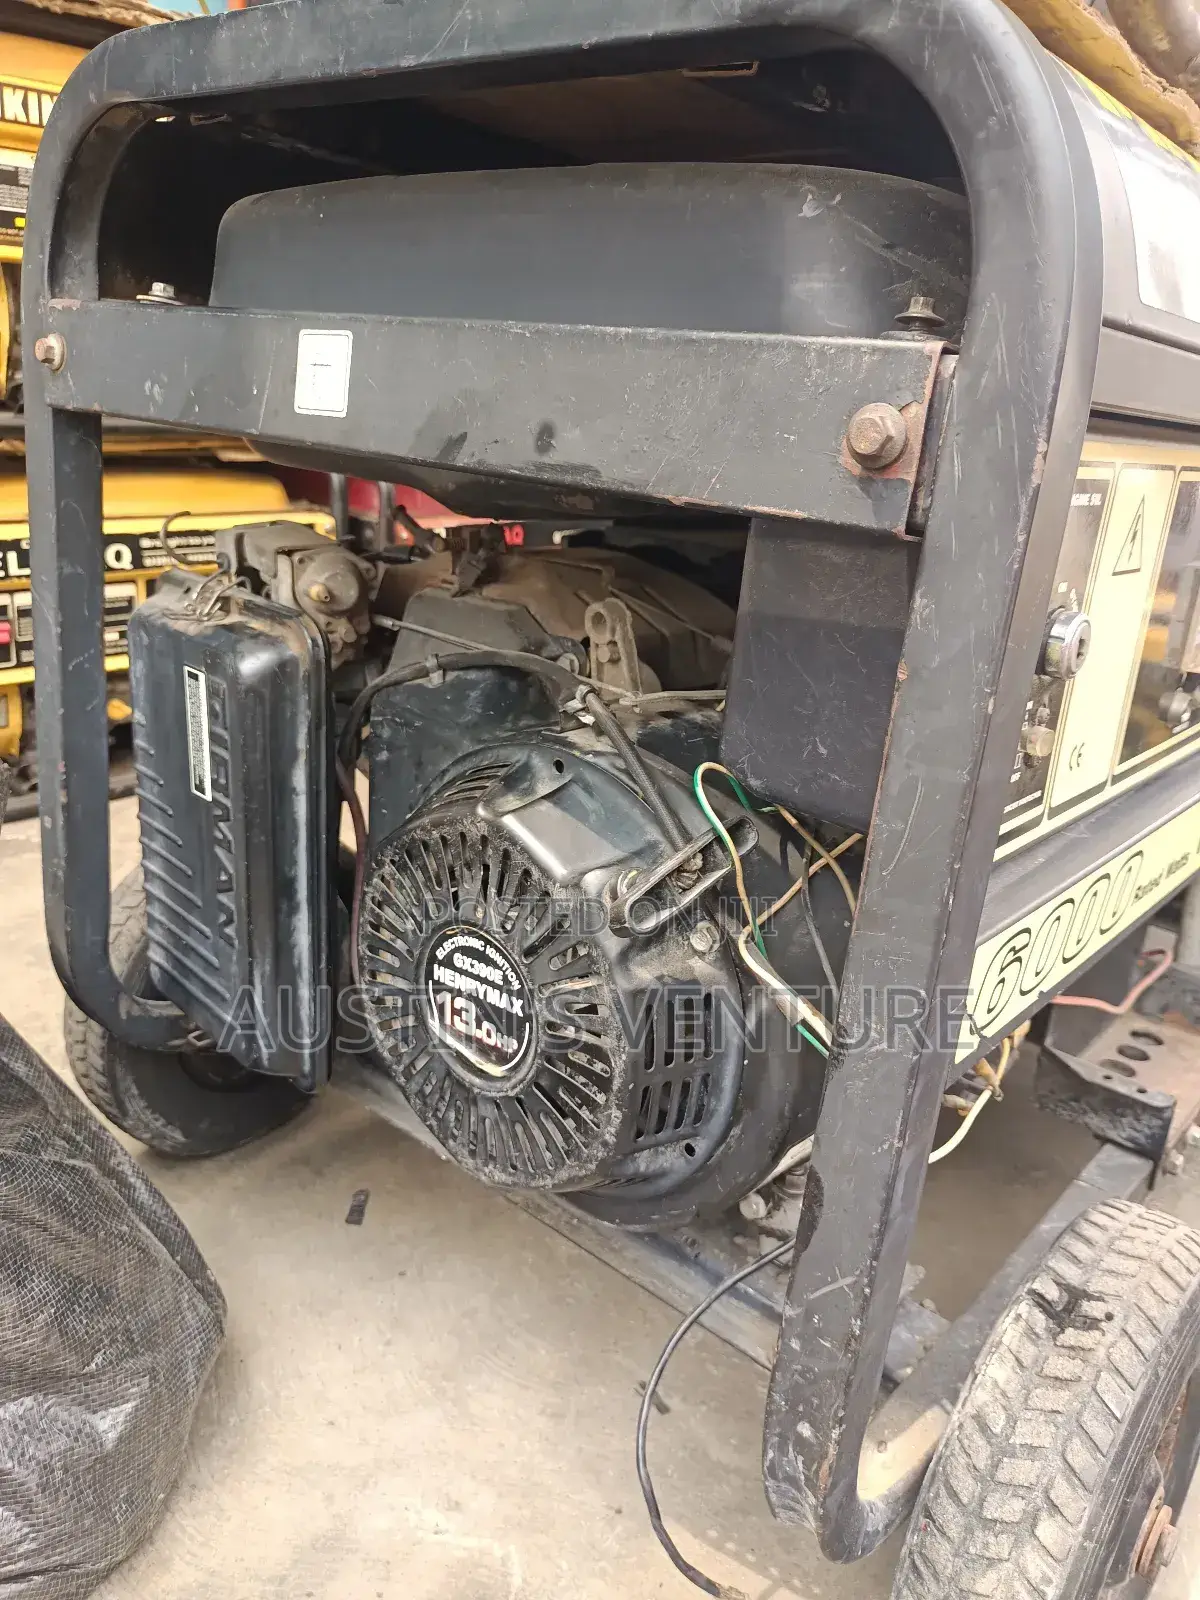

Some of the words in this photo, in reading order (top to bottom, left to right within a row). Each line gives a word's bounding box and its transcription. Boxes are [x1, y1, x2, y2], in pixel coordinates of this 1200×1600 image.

[435, 935, 485, 961] ELECTRONIC
[485, 944, 522, 991] IGNITION
[452, 952, 504, 985] GX390E
[970, 850, 1144, 1035] 6000
[433, 963, 524, 1017] HENRYMAX
